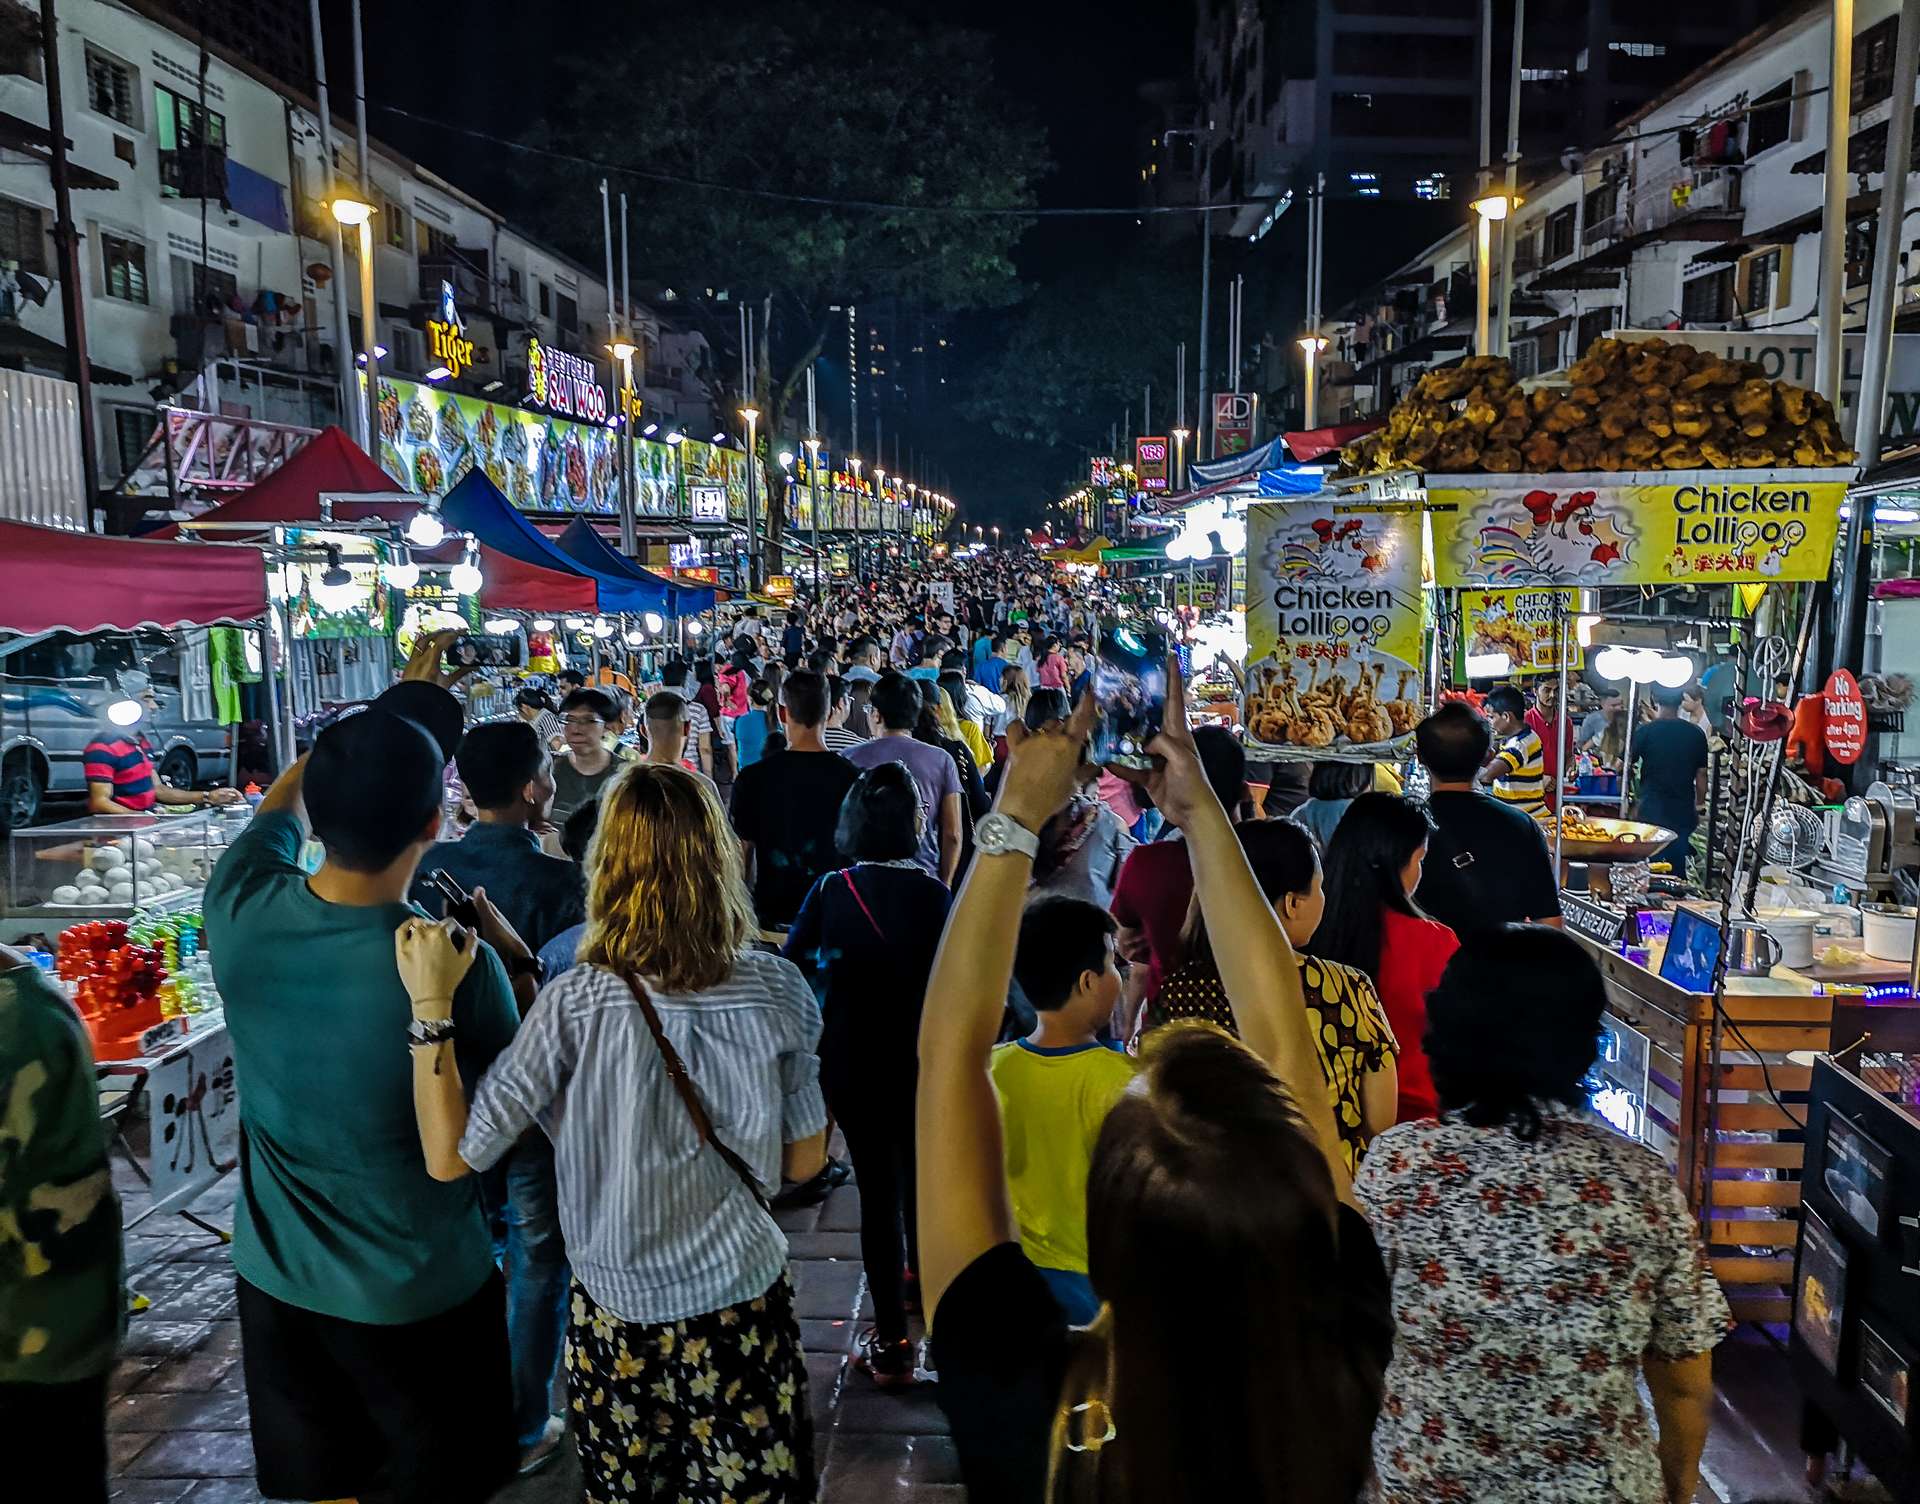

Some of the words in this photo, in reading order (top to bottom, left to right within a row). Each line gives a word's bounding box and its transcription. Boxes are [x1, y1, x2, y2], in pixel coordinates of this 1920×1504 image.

[426, 320, 474, 379] Tiger
[1727, 346, 1863, 381] OTL
[546, 345, 595, 384] RESTORAN
[548, 370, 573, 415] SAI
[573, 378, 606, 423] WOO
[1218, 397, 1250, 420] 4D
[1673, 486, 1810, 513] Chicken
[1676, 516, 1807, 557] Lollipop
[1274, 585, 1393, 610] Chicken
[1514, 592, 1572, 608] CHICKEN
[1278, 612, 1391, 646] Lollipop
[1515, 607, 1569, 624] POPCORN
[1835, 674, 1850, 696] No
[1825, 697, 1862, 721] Parking
[1580, 910, 1616, 940] BREATH
